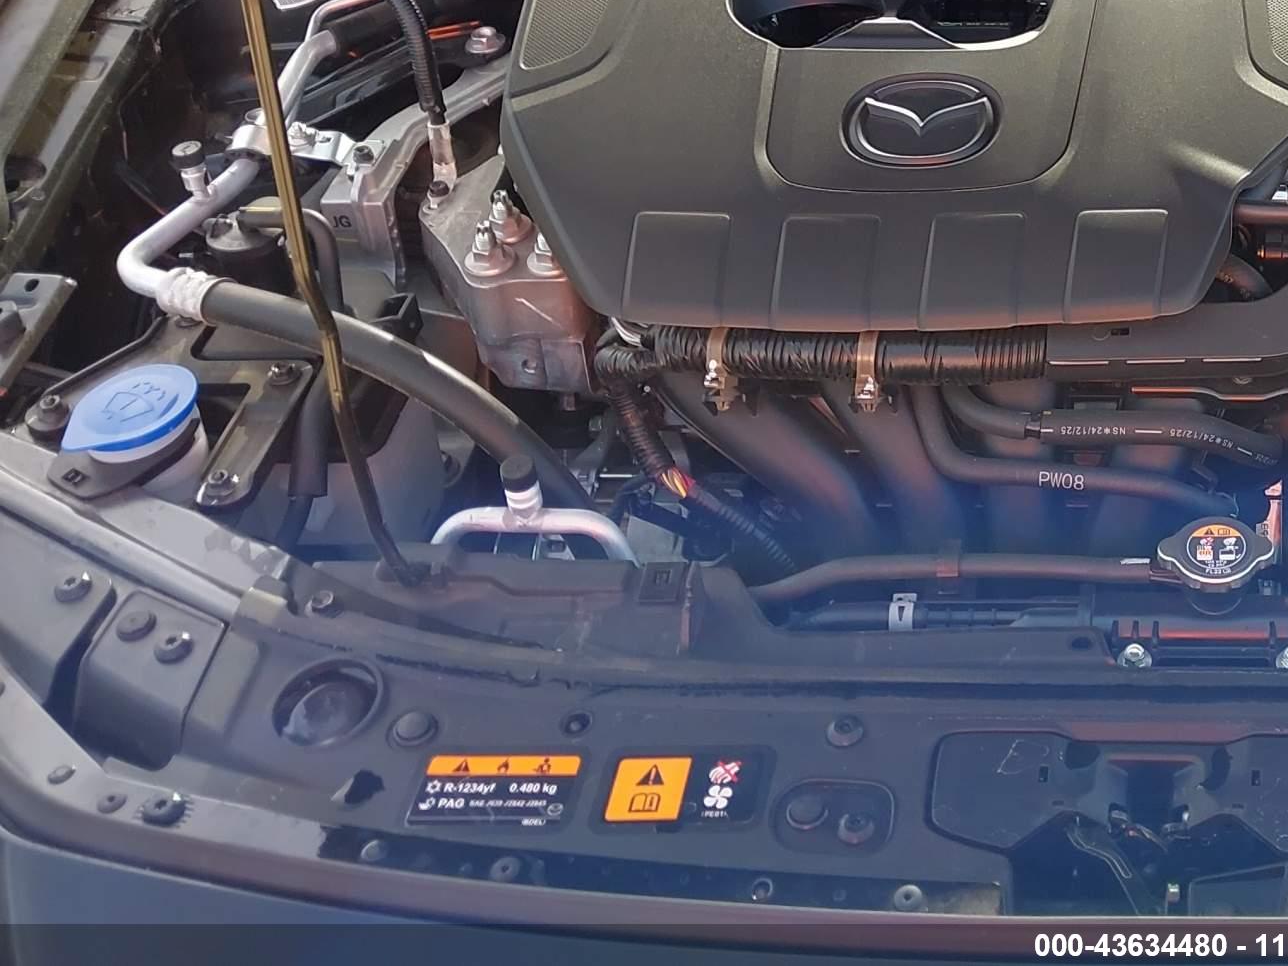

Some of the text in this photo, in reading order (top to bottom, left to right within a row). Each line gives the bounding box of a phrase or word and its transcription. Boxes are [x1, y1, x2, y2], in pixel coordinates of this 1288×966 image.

[1038, 471, 1086, 491] PW08
[509, 782, 540, 792] 0.480
[542, 782, 557, 795] kg
[437, 798, 465, 808] PAG
